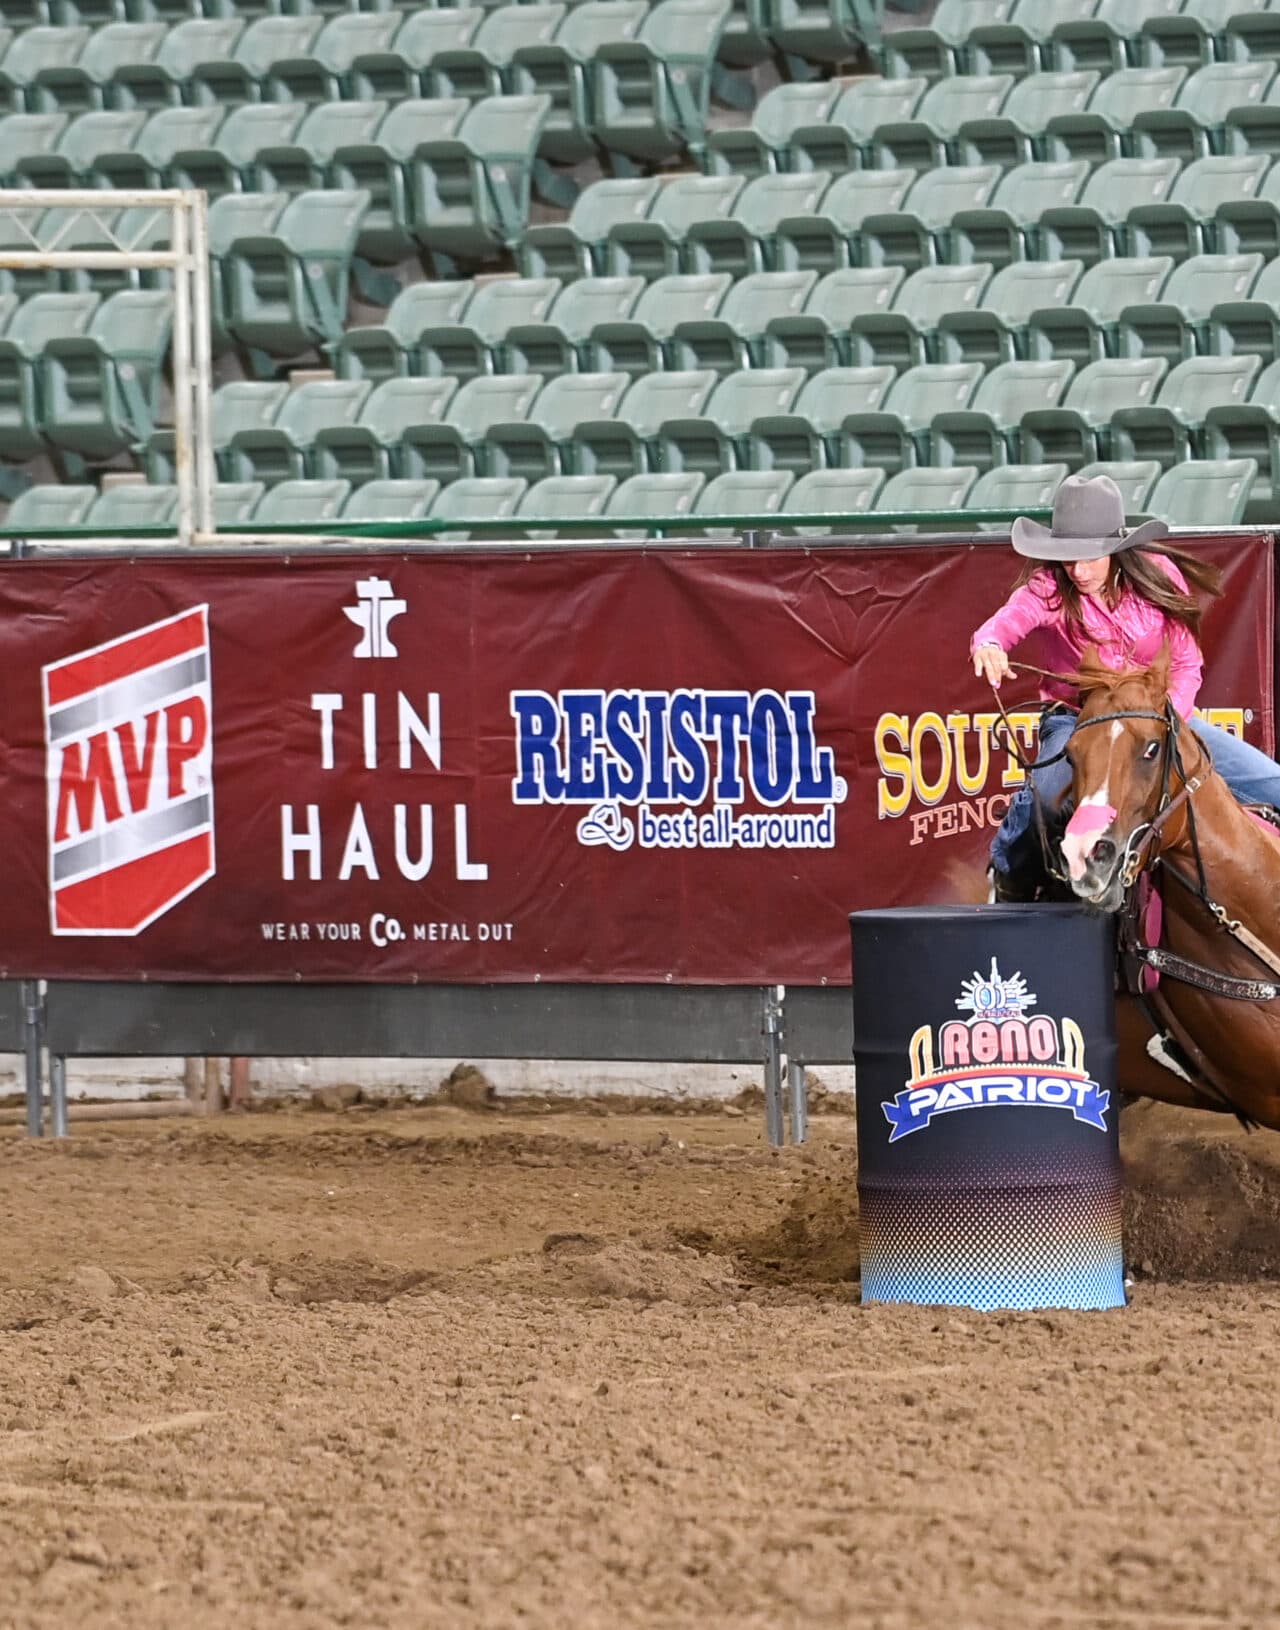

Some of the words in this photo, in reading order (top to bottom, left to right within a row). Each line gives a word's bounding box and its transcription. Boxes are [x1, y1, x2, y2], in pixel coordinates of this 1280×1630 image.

[311, 691, 441, 770] TIN
[511, 689, 836, 806] RESISTOL
[53, 696, 208, 843] MVP
[281, 802, 489, 881] HAUL
[640, 804, 697, 846] best
[701, 804, 835, 846] all-around
[909, 793, 1011, 846] FENC
[261, 923, 311, 941] WEAR
[316, 923, 362, 941] YOUR
[369, 913, 406, 947] Co.
[413, 923, 470, 941] METAL
[478, 923, 514, 941] OUT
[908, 1075, 1094, 1117] PATRIOT
